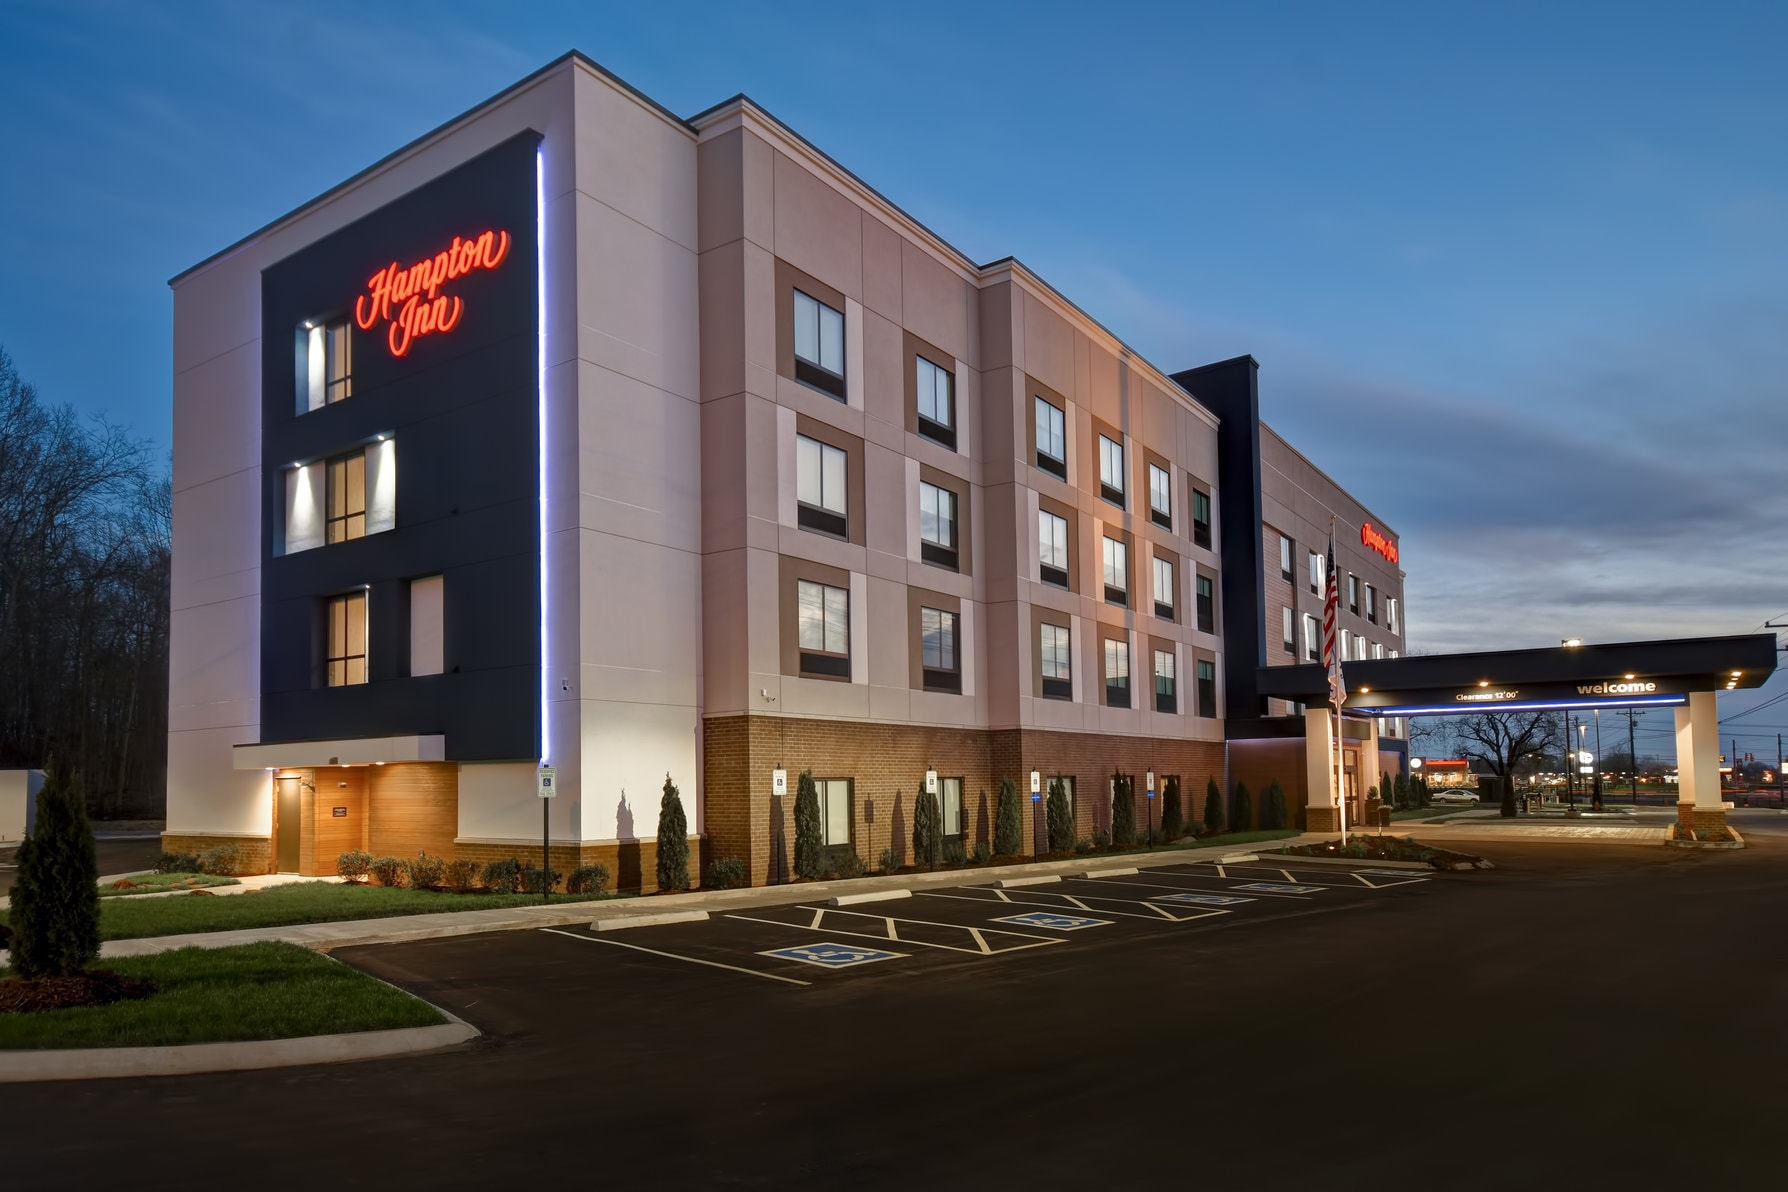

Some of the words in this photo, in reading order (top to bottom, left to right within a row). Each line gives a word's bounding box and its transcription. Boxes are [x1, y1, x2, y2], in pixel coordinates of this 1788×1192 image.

[356, 230, 508, 329] Hampton
[388, 294, 461, 357] Inn
[1455, 693, 1493, 701] Clearance
[1576, 681, 1657, 695] welcome
